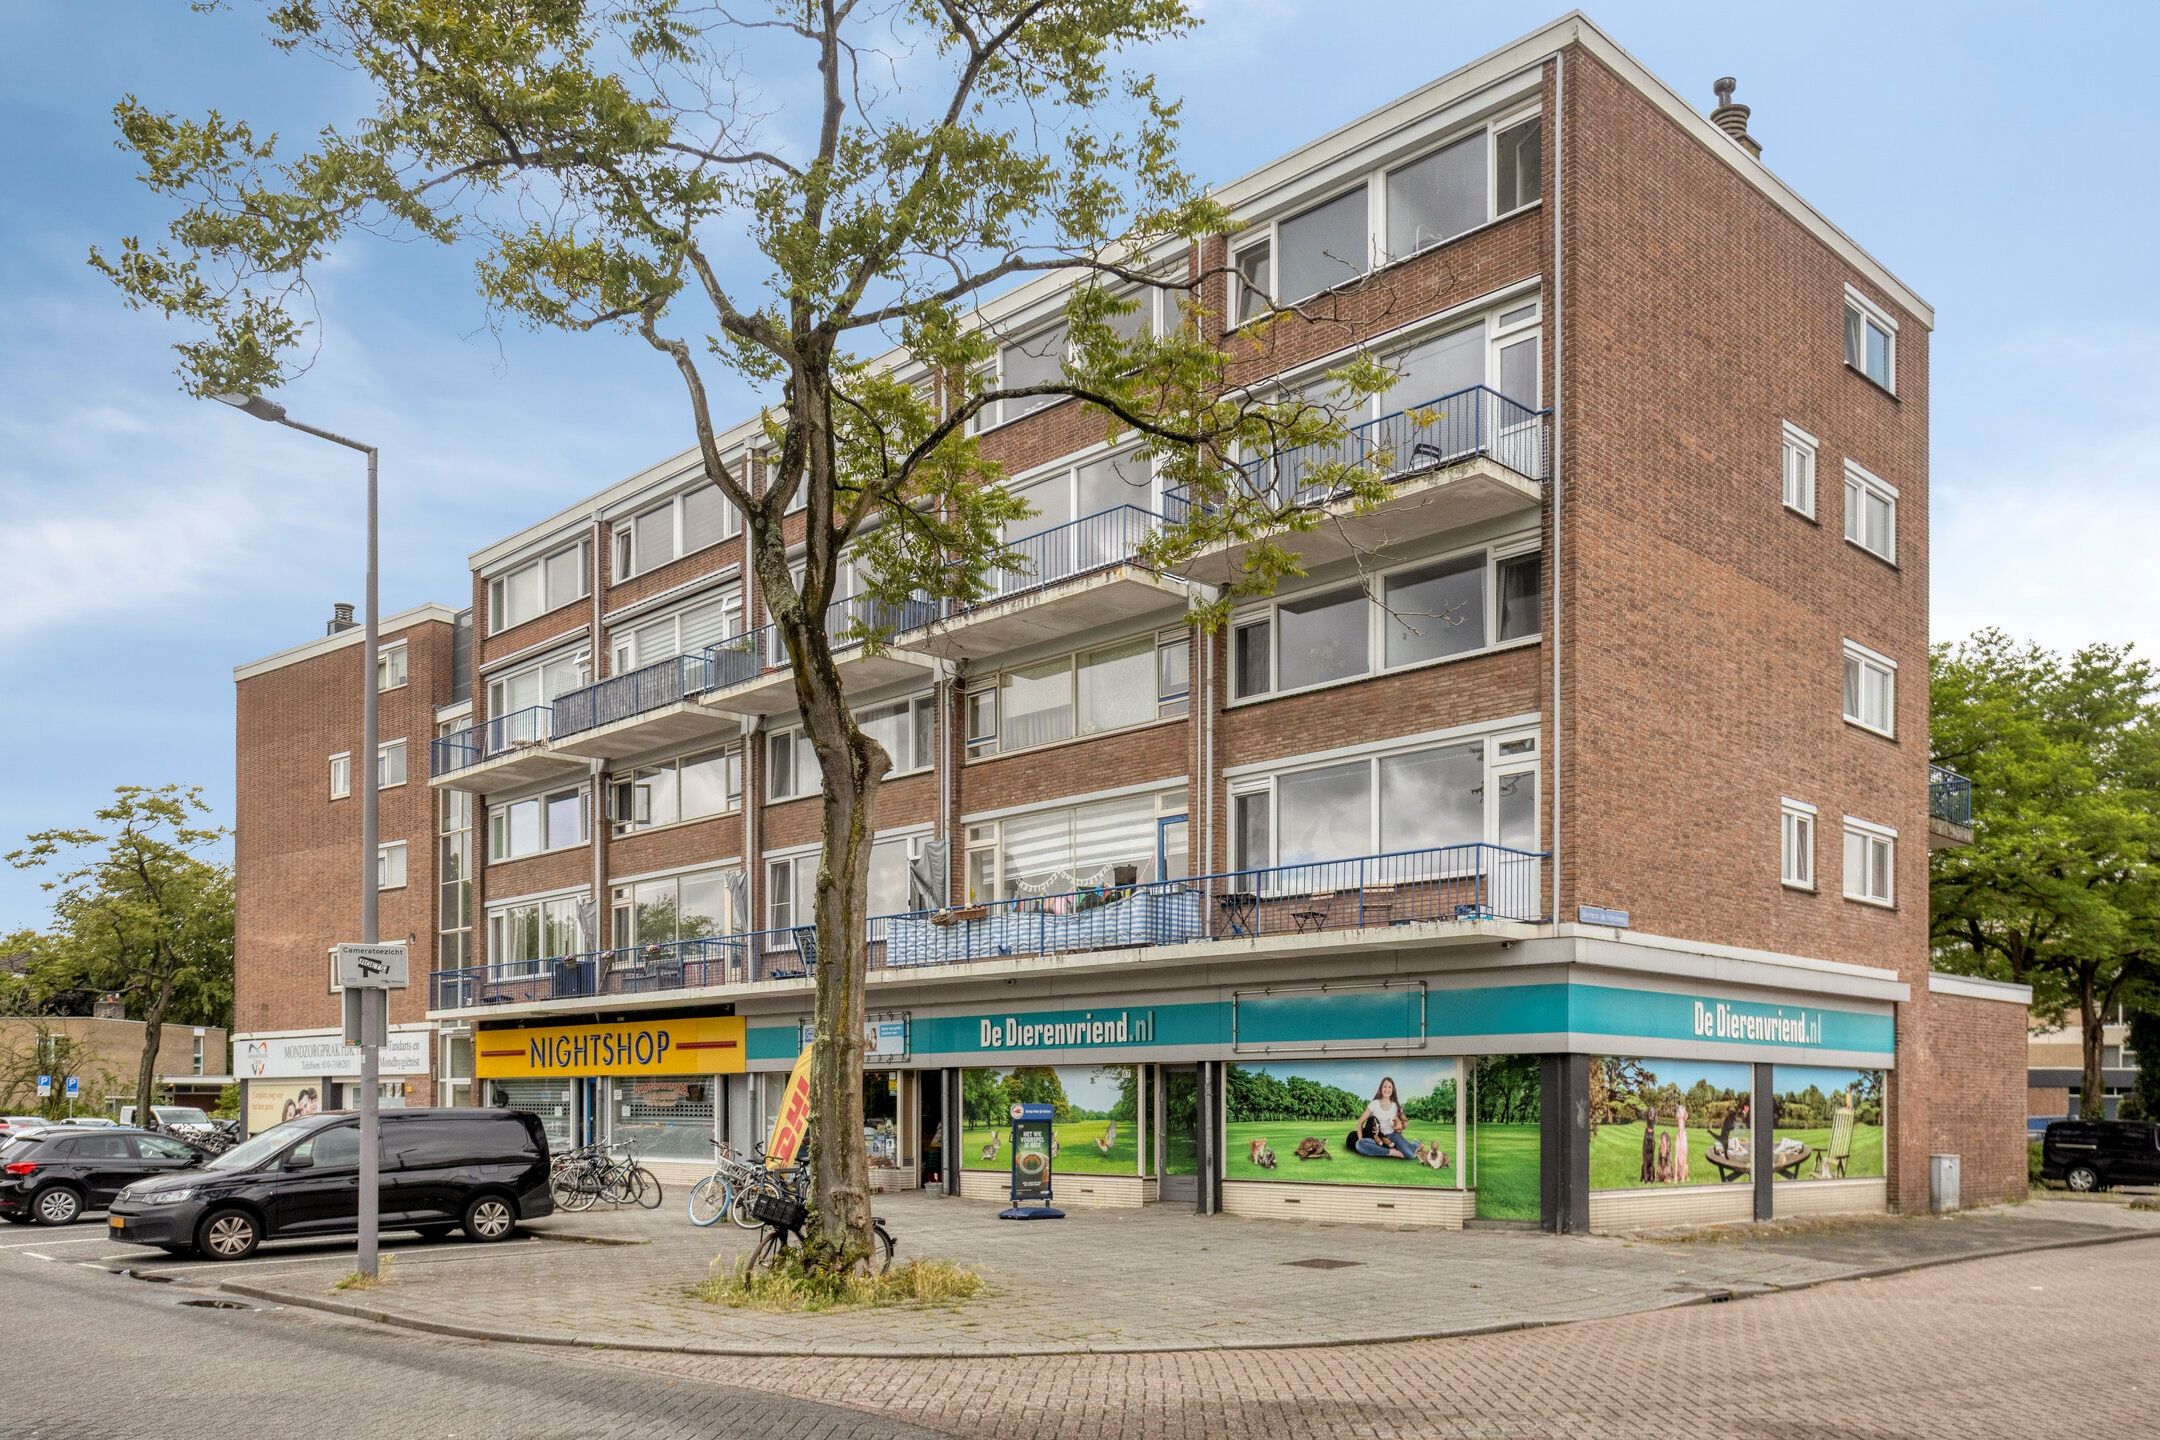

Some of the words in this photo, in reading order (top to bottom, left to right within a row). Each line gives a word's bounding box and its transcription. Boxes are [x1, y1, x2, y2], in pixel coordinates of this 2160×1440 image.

[343, 946, 404, 956] Cameratoezicht
[980, 1019, 1003, 1048] De
[1005, 1010, 1154, 1047] Dierenvriend.nl
[1694, 1001, 1713, 1037] De
[1716, 1003, 1822, 1044] Dierenvriend.nl
[530, 1030, 670, 1068] NIGHTSHOP
[40, 1076, 48, 1086] P
[68, 1079, 76, 1087] P
